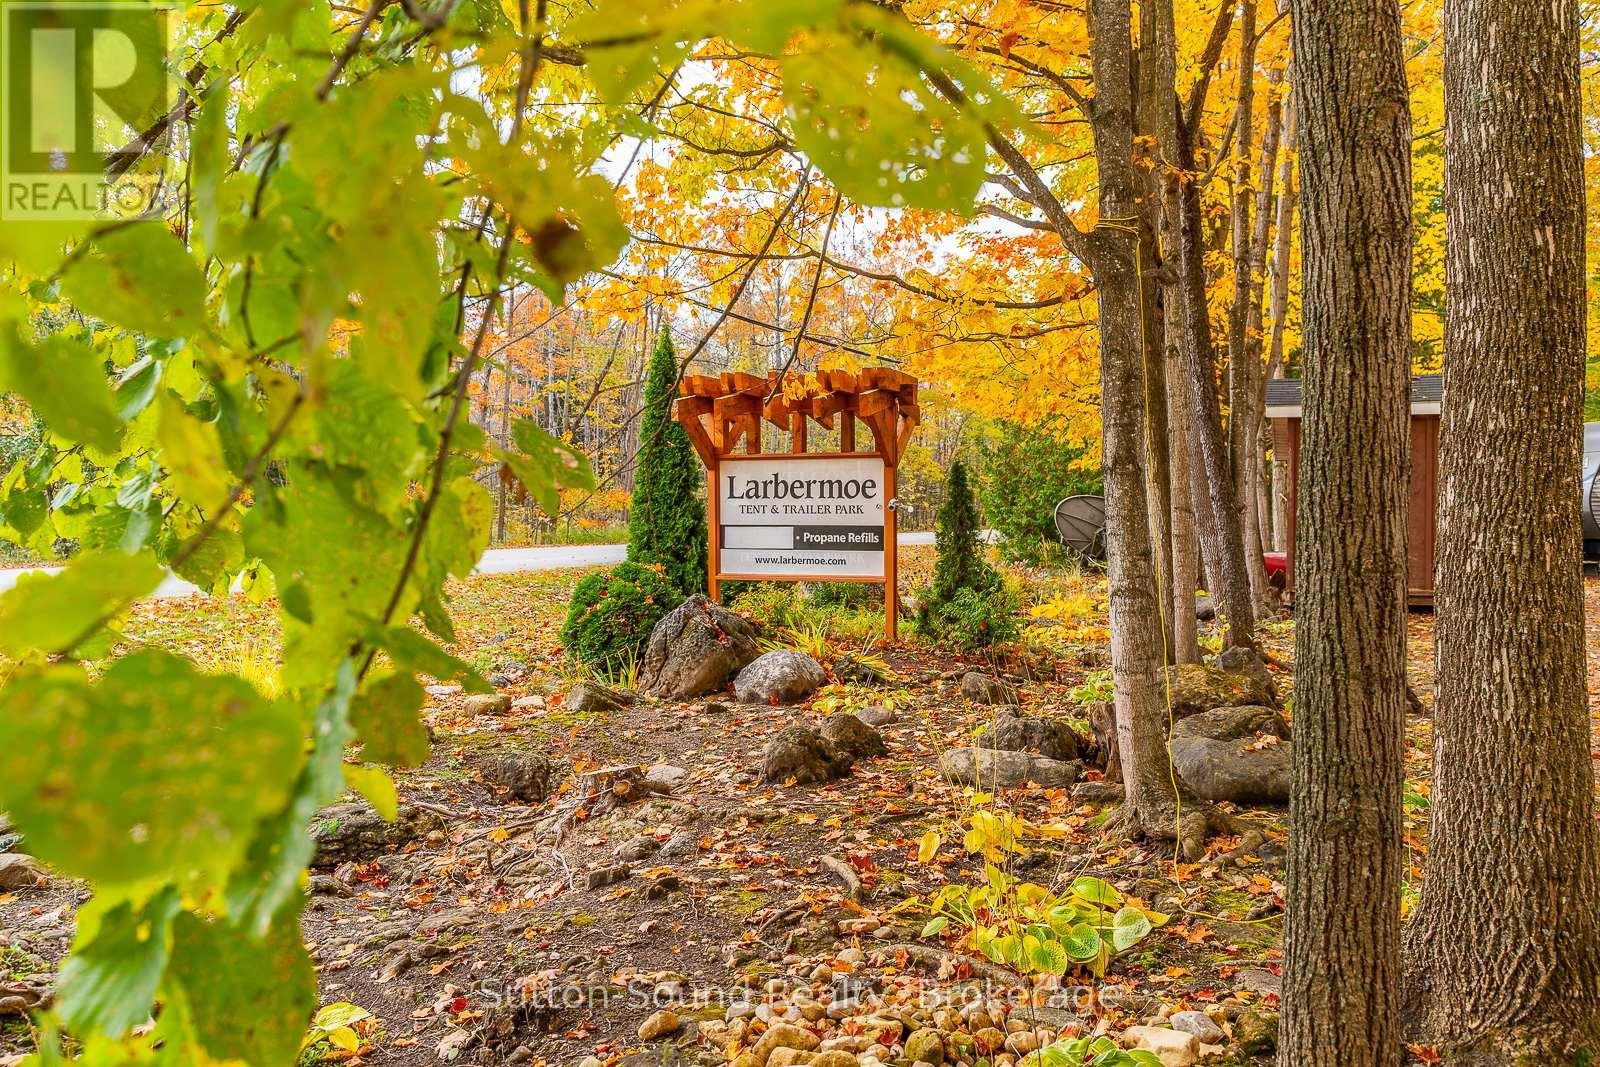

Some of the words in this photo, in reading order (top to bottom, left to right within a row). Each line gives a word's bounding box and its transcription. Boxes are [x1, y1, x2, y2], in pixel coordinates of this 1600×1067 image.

[727, 472, 877, 499] Larbermoe
[739, 504, 768, 514] TENT
[770, 504, 779, 514] &
[783, 504, 832, 514] TRAILER
[835, 504, 864, 514] PARK
[803, 532, 847, 544] Propane
[848, 532, 879, 543] Refills
[755, 556, 847, 565] www.larbermoe.com
